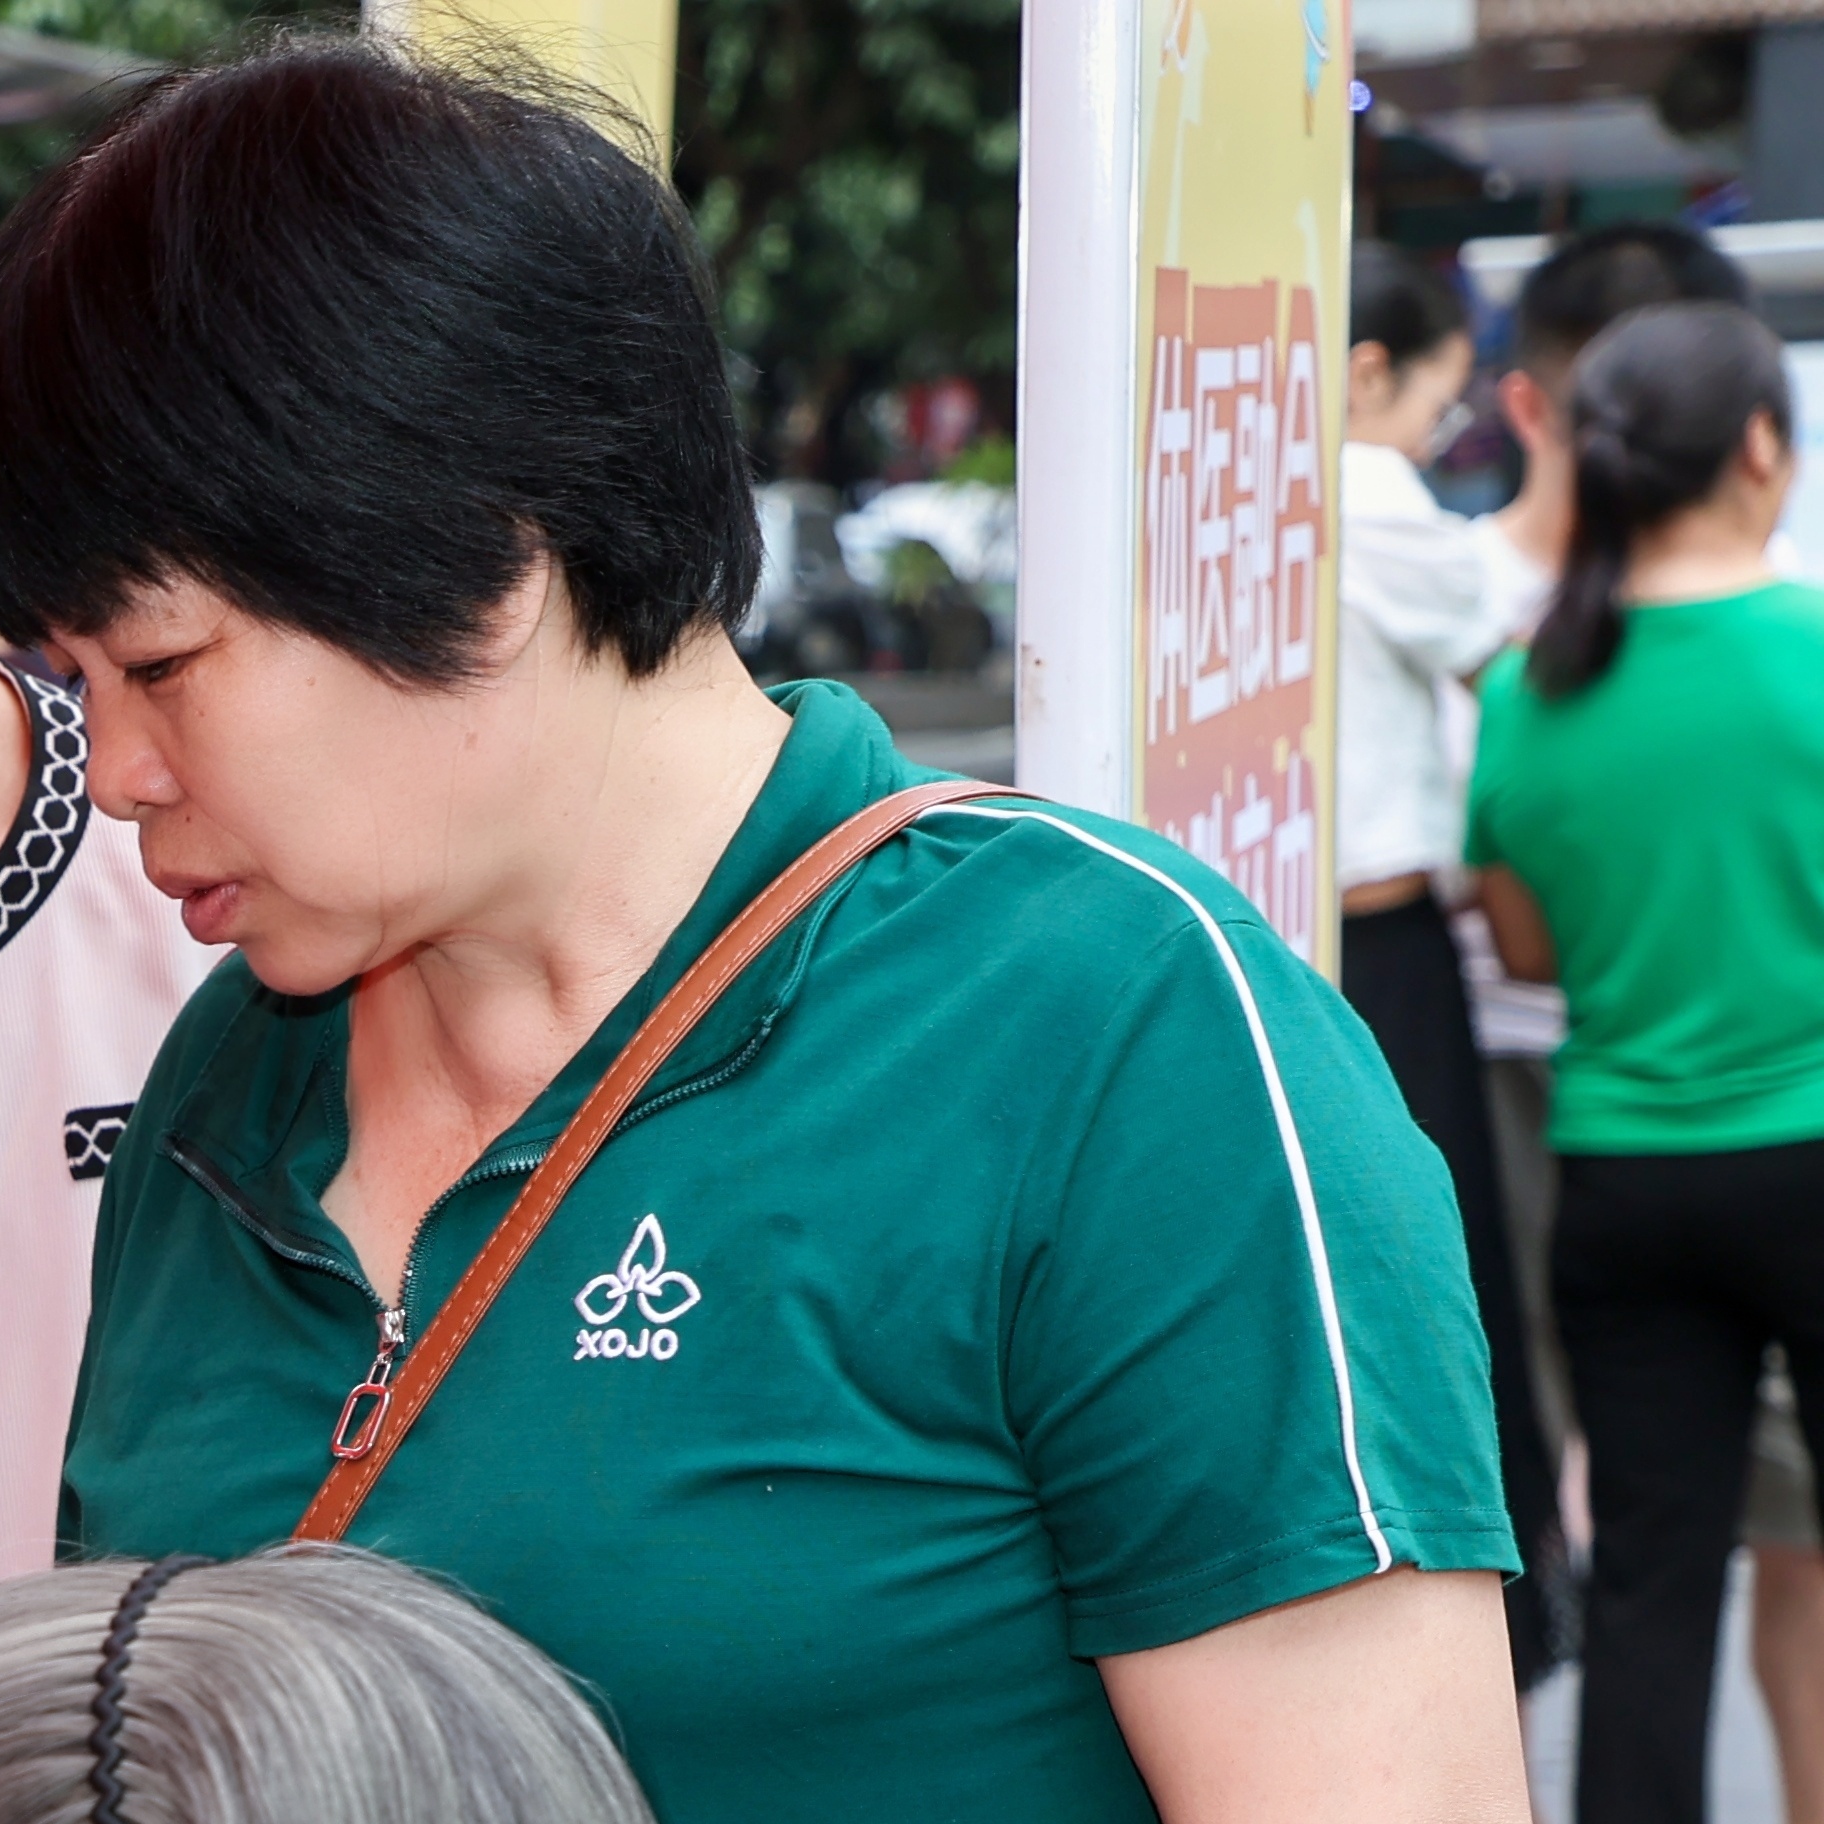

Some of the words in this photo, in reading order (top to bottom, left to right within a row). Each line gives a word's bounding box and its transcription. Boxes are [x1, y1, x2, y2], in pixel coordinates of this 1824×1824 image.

[1145, 335, 1320, 744] 体医融合
[573, 1328, 679, 1361] XOJO
